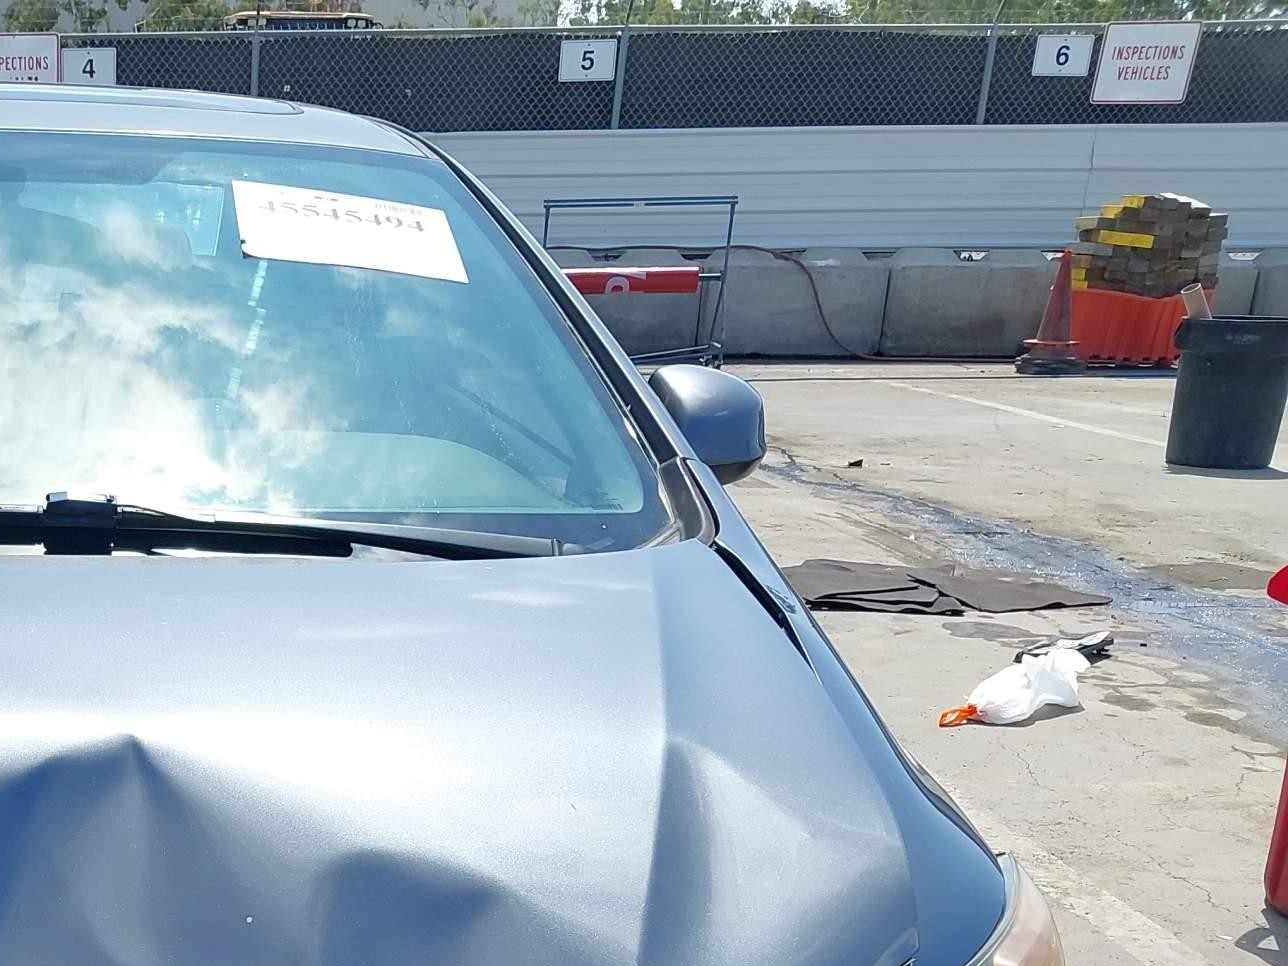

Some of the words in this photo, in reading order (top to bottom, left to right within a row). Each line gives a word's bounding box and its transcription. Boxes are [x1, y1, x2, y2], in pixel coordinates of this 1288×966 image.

[581, 50, 595, 71] 5
[1056, 45, 1070, 66] 6
[1112, 45, 1186, 61] INSPECTIONS
[82, 59, 96, 79] 4
[1118, 66, 1171, 81] VEHICLES
